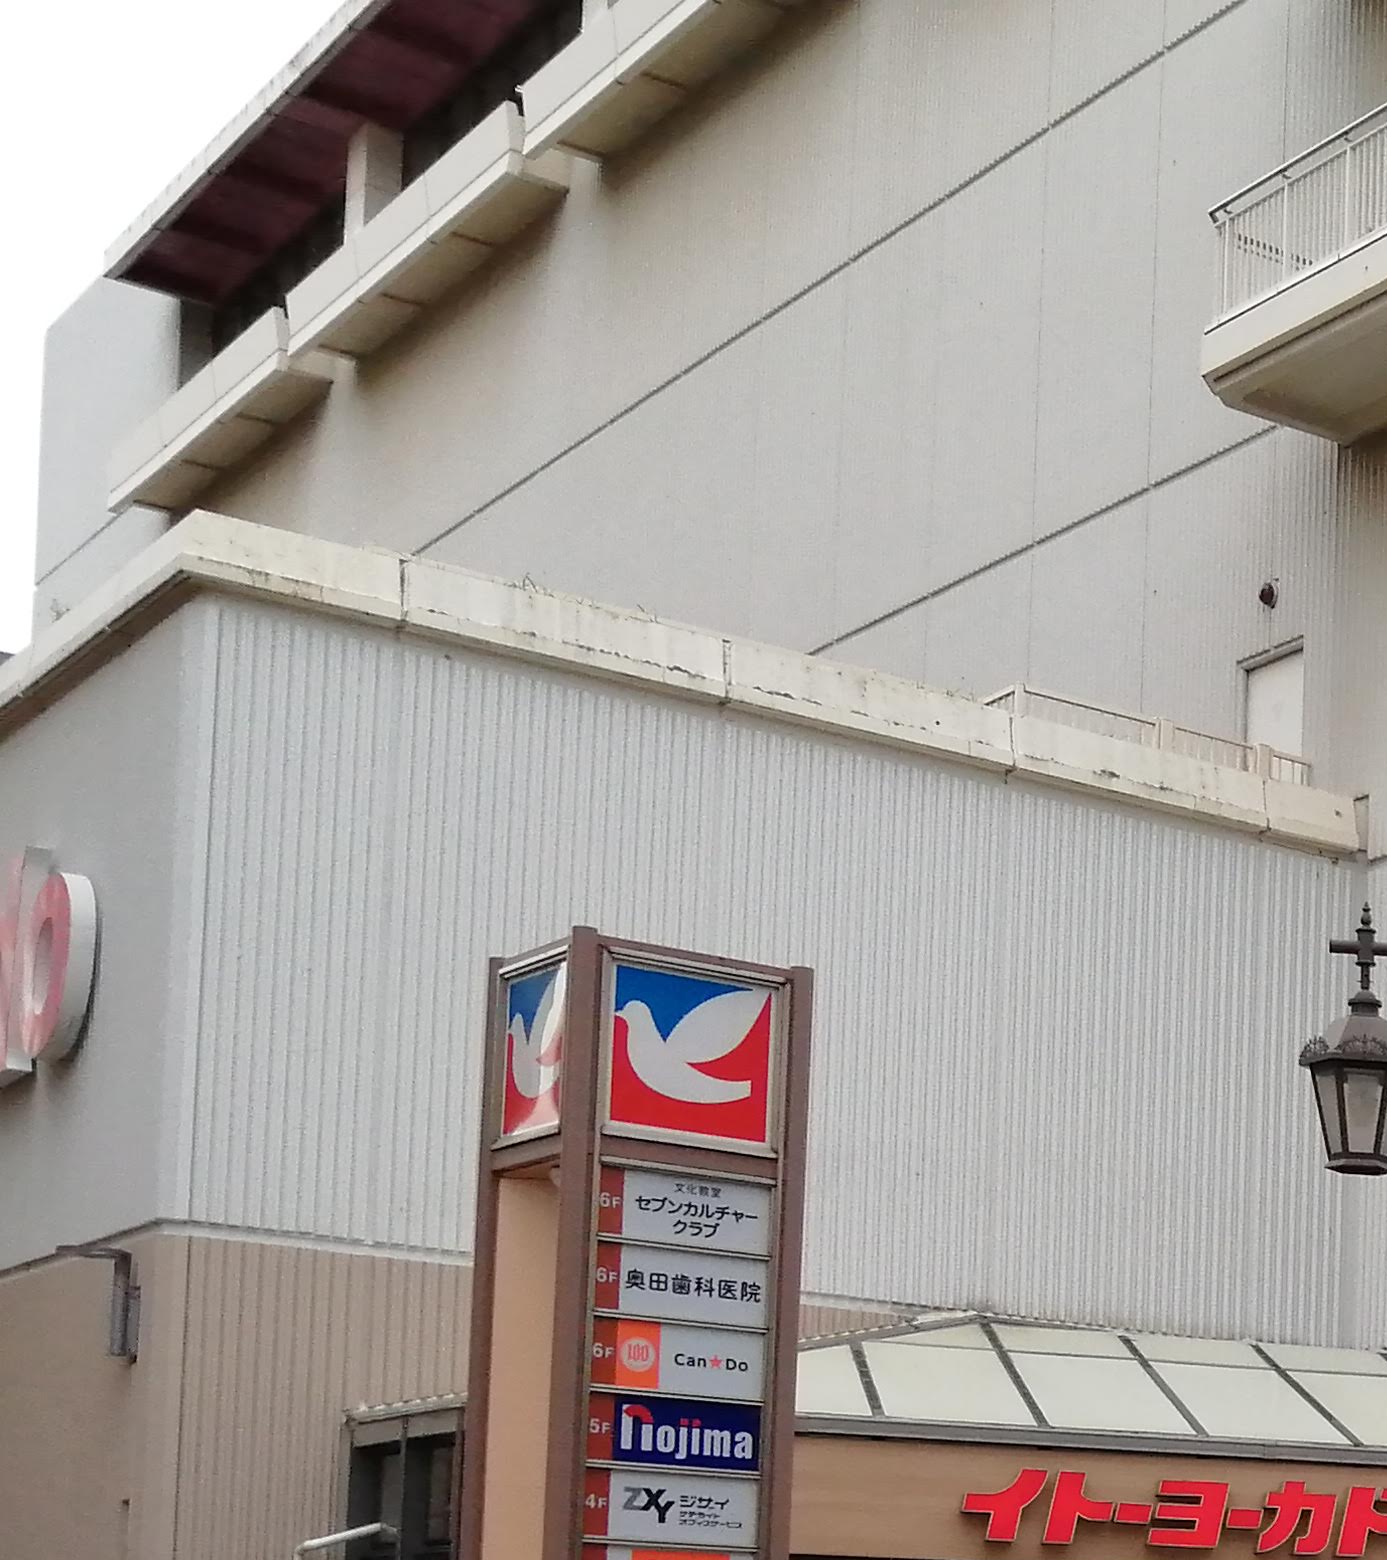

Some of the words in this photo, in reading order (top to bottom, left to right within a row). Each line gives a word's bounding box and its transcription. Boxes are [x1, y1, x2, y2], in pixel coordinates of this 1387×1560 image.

[674, 1183, 721, 1198] 文化教室
[600, 1193, 621, 1208] 6F
[635, 1196, 758, 1224] セブンカルチャー
[672, 1219, 720, 1239] クラブ
[596, 1269, 618, 1283] 6F
[624, 1267, 761, 1303] 奥田歯科医院
[593, 1343, 613, 1358] 6F
[627, 1345, 649, 1363] 100
[589, 1418, 611, 1434] 5F
[585, 1494, 607, 1509] 4F
[623, 1486, 675, 1524] ZXY
